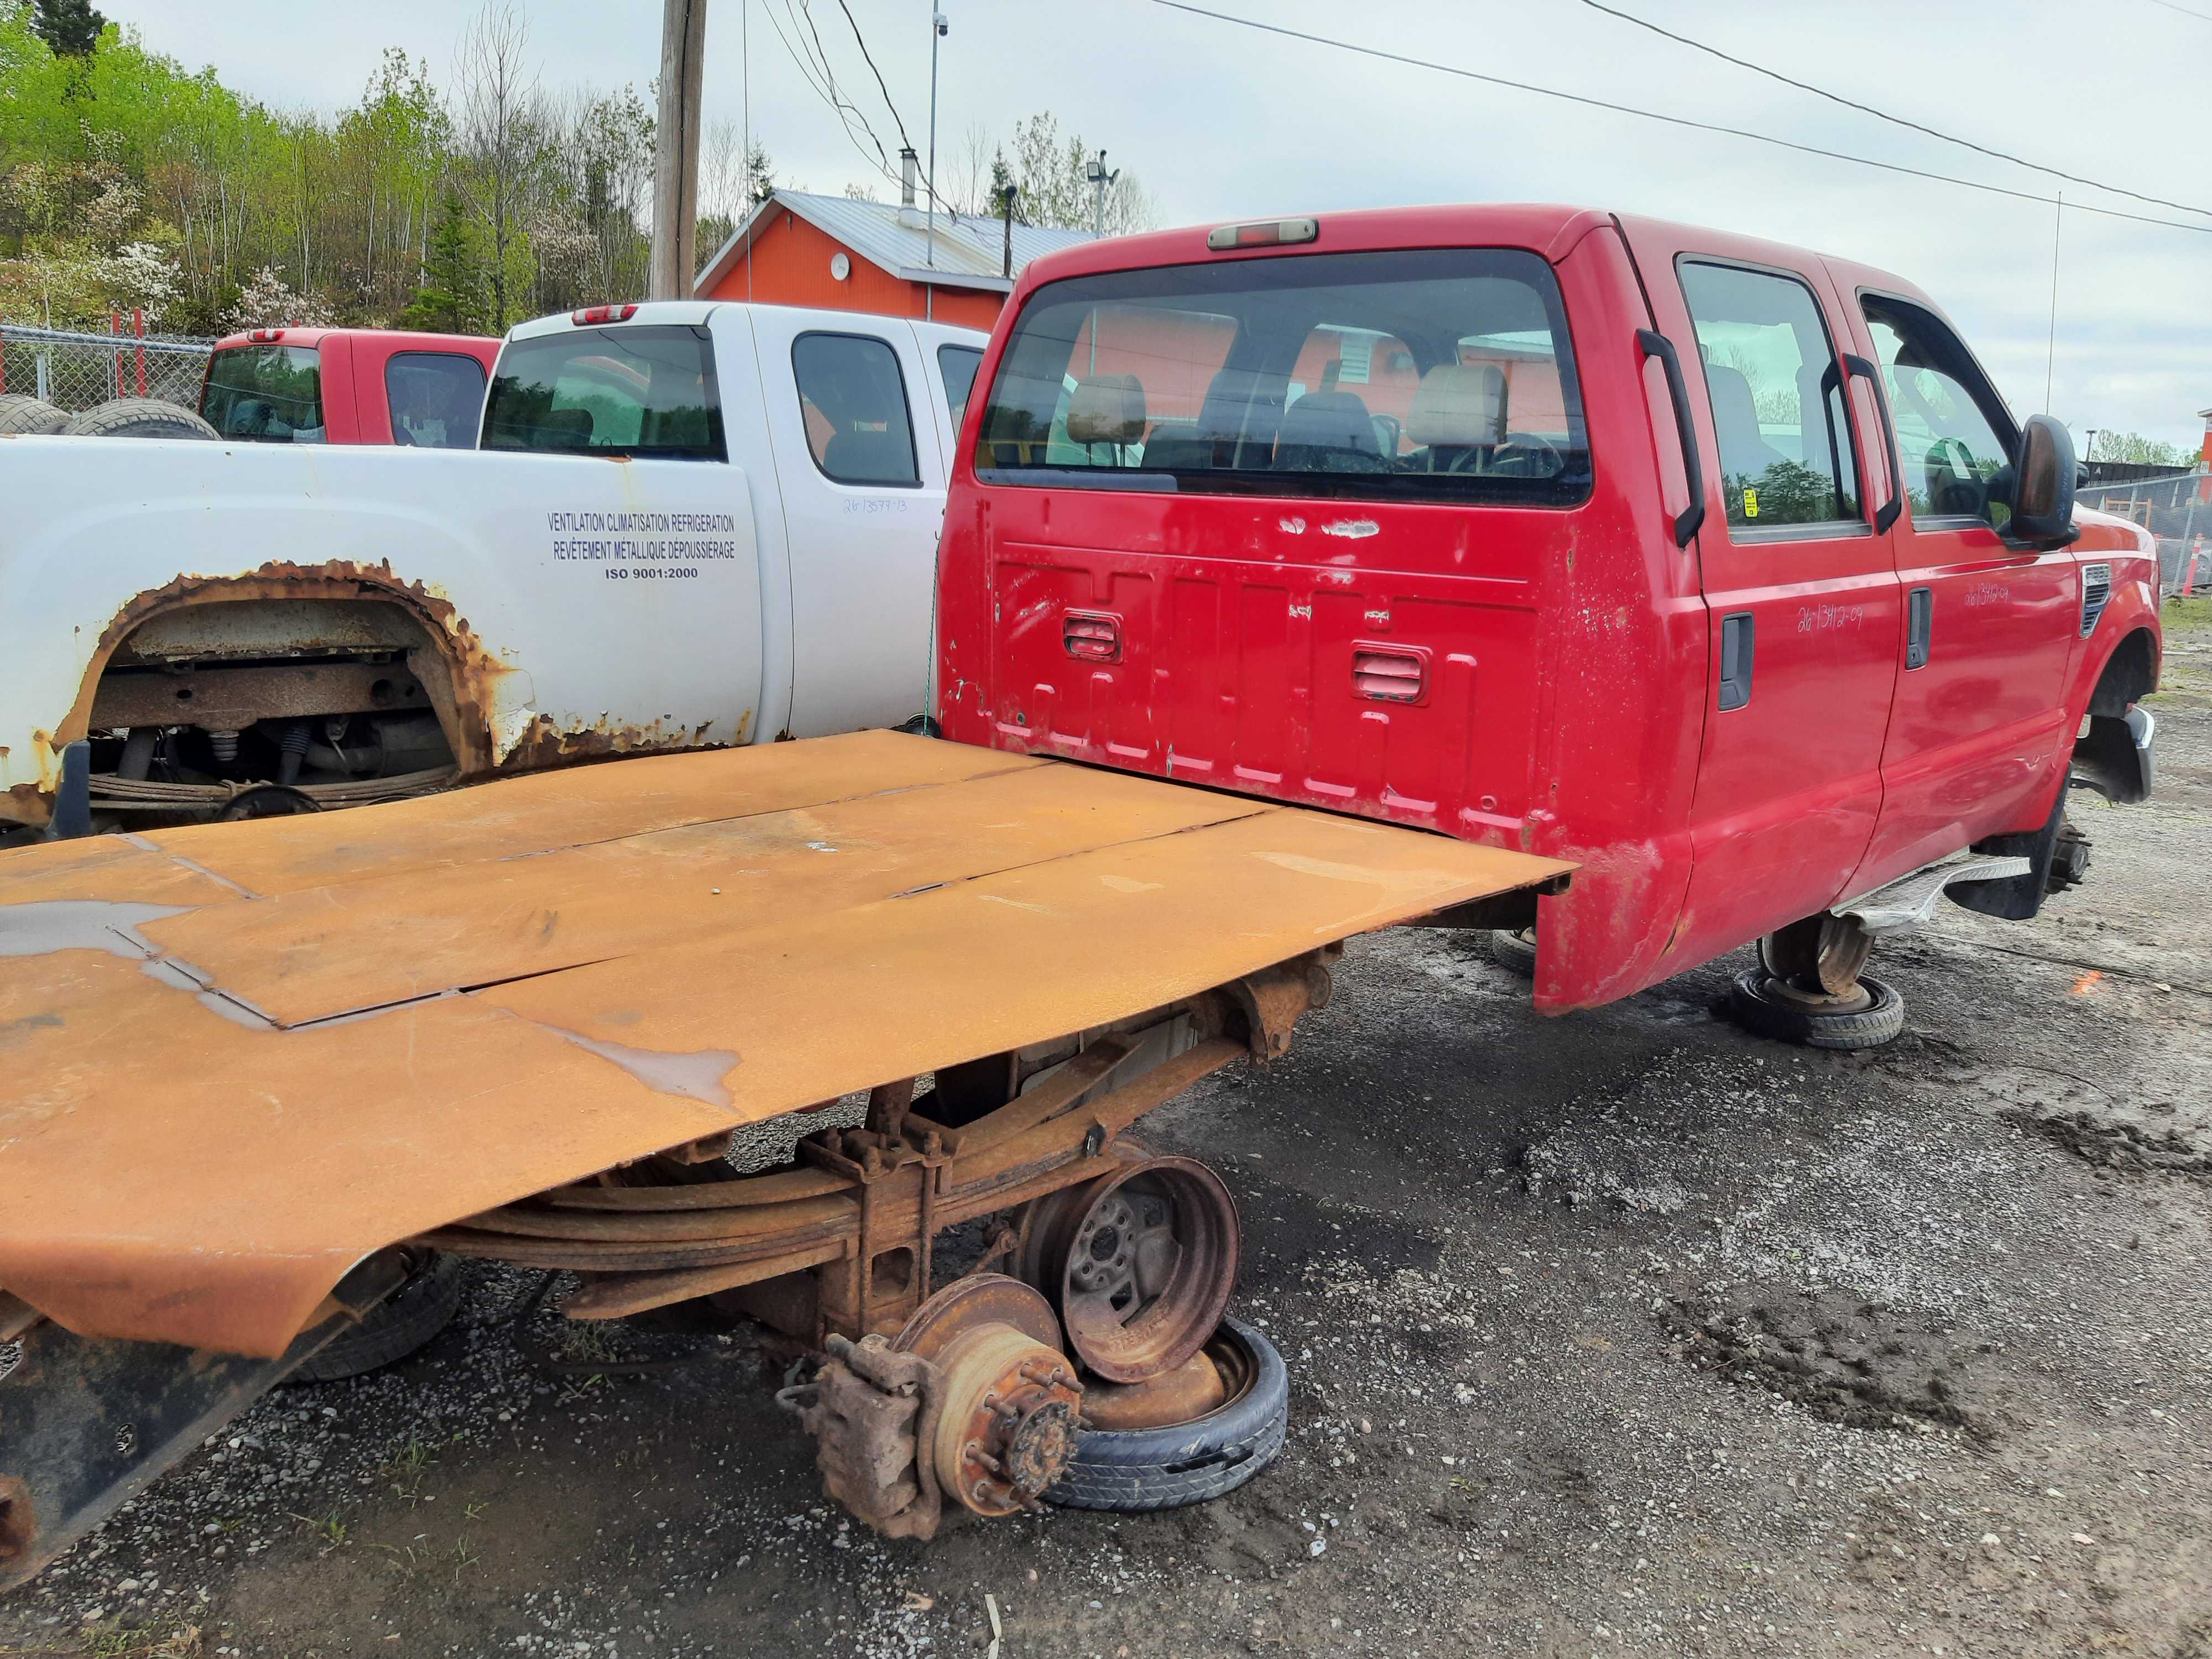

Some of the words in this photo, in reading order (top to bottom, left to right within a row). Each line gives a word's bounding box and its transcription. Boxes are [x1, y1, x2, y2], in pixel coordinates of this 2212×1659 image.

[547, 513, 604, 531] VENTILATION
[607, 513, 669, 532] CLIMATISATION
[672, 514, 734, 533] REFRIGERATION
[554, 537, 612, 560] REVÊTEMENT
[614, 536, 666, 561] MÉTALLIQUE
[669, 536, 735, 559] DÉPOUSSIÉRAGE
[605, 569, 628, 579] ISO
[633, 568, 698, 579] 9001:2000
[1798, 603, 1863, 633] 26-13412-09
